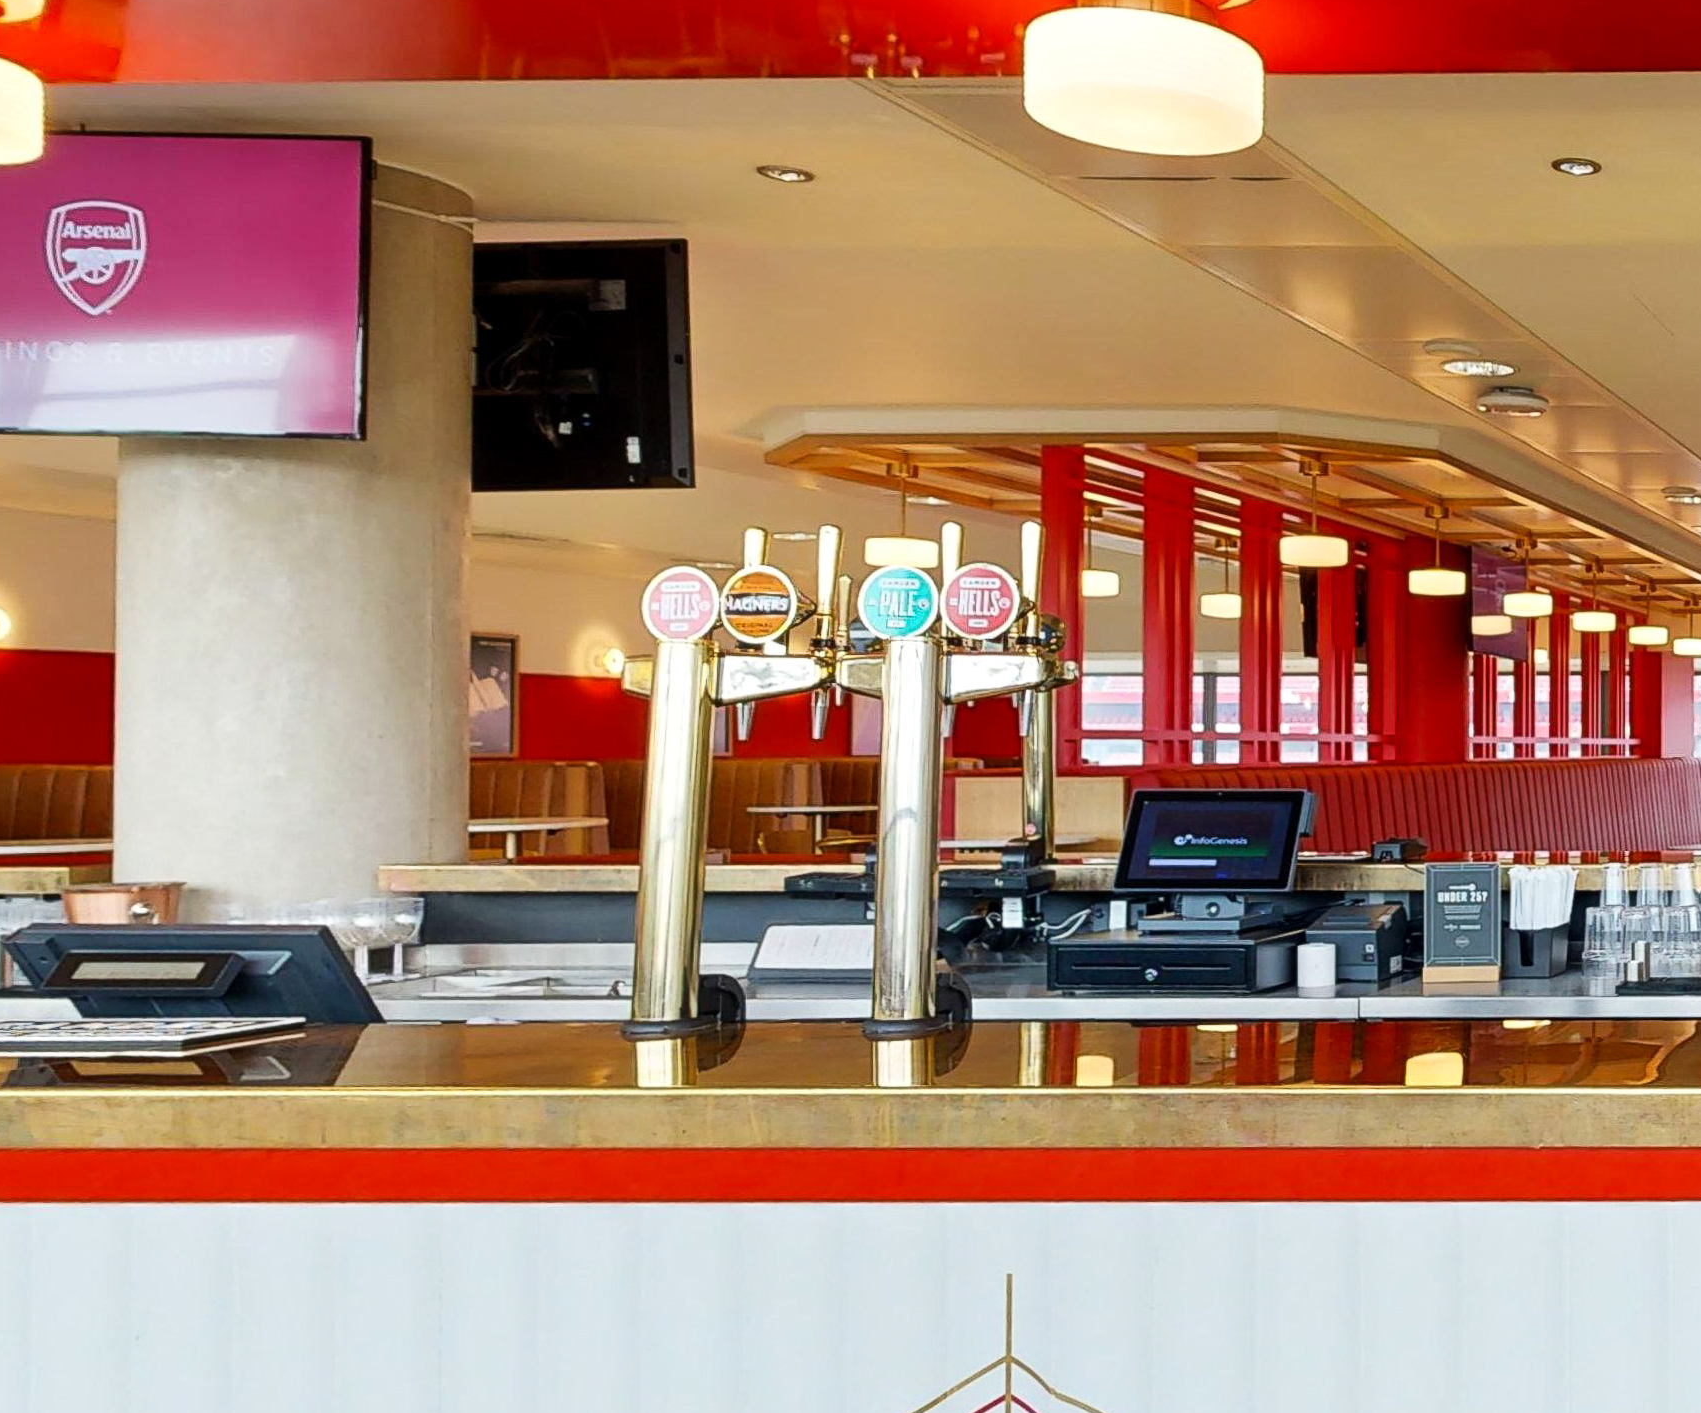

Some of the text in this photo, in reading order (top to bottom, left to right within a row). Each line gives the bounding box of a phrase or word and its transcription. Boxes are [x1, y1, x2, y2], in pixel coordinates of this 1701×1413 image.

[61, 220, 133, 240] Arsenal
[660, 593, 700, 620] HELLS
[878, 590, 917, 617] PALE
[958, 590, 1000, 617] HELLS
[1190, 836, 1249, 846] InfoGenesis
[1437, 891, 1468, 903] UNDER
